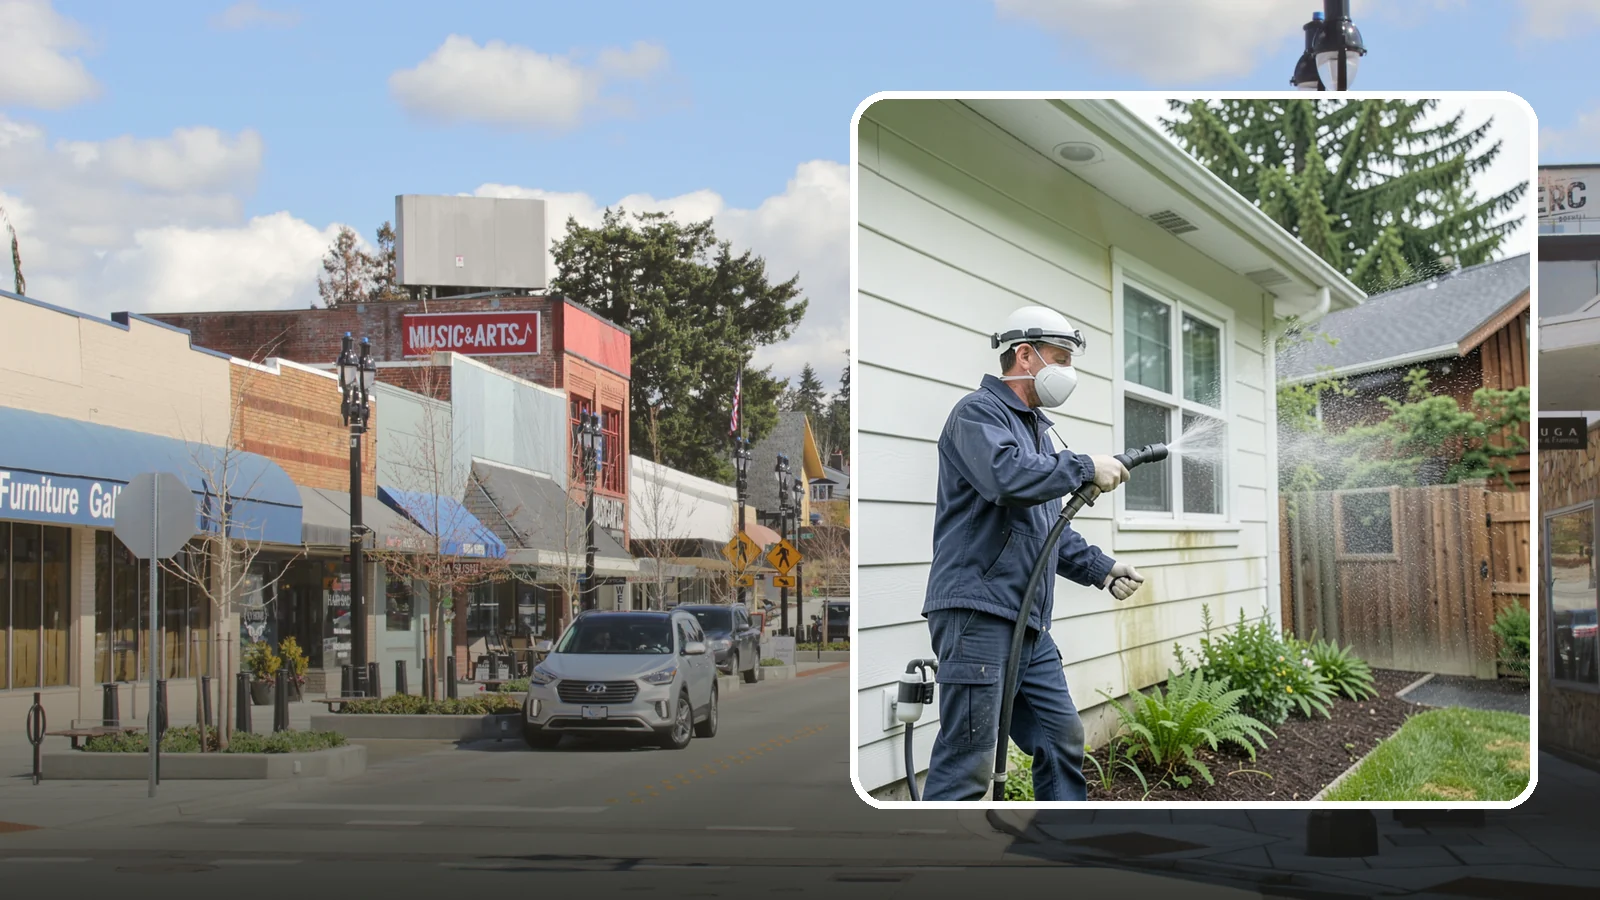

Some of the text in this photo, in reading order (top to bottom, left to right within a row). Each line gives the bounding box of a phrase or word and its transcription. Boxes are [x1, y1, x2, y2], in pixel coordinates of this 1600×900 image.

[409, 322, 520, 349] MUSIC&ARTS
[1540, 427, 1578, 437] UGA
[0, 471, 122, 519] Furniture Gal
[453, 562, 480, 575] SUSHI
